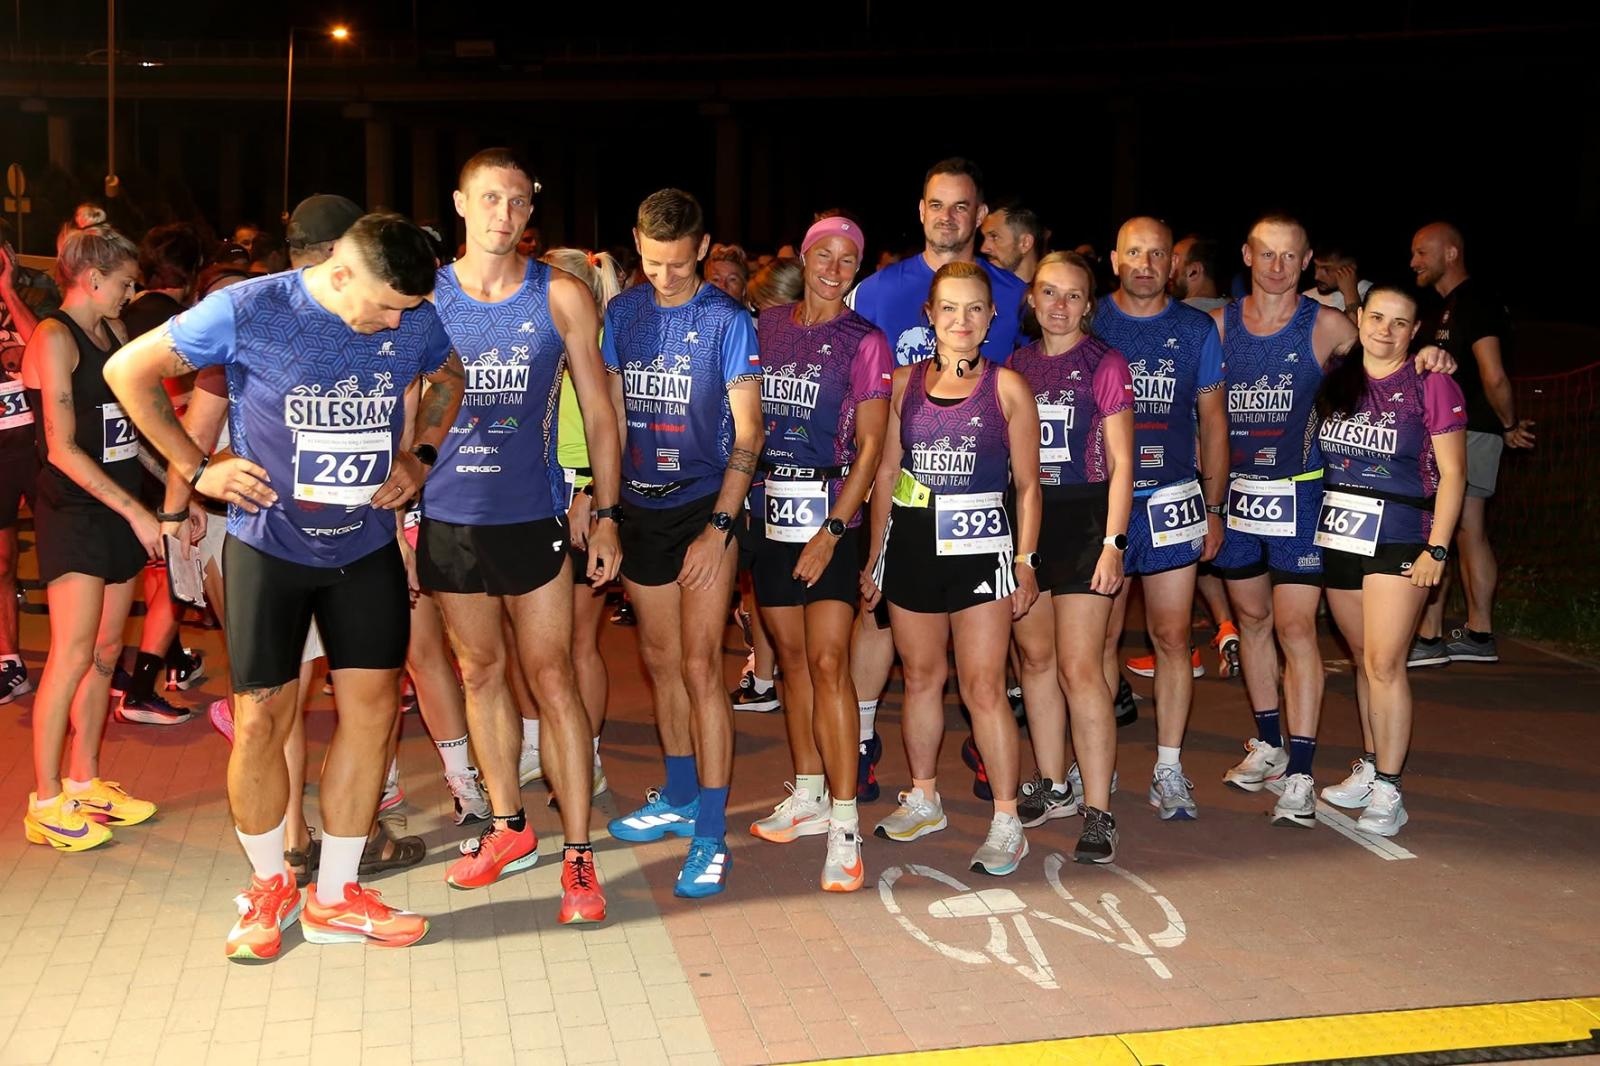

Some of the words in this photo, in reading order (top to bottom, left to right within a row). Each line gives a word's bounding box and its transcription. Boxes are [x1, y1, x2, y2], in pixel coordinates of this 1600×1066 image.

[465, 368, 527, 390] LESIAN
[626, 371, 689, 401] SILESIAN
[1134, 378, 1174, 401] SIAN
[499, 392, 523, 405] TEAM
[1151, 402, 1172, 415] TEAM
[1230, 392, 1292, 410] SILESIAN
[289, 398, 393, 426] SILESIAN
[791, 405, 812, 421] TEAM
[1267, 412, 1289, 423] TEAM
[1320, 419, 1395, 453] SILESIAN
[1320, 440, 1365, 457] TRIATHLON
[313, 453, 378, 485] 267
[913, 451, 975, 475] SILESIAN
[949, 474, 971, 488] TEAM
[1133, 480, 1159, 488] IGO
[770, 498, 813, 525] 346
[1163, 498, 1200, 528] 311
[1236, 495, 1282, 520] 466
[951, 509, 1002, 537] 393
[1323, 508, 1367, 536] 467
